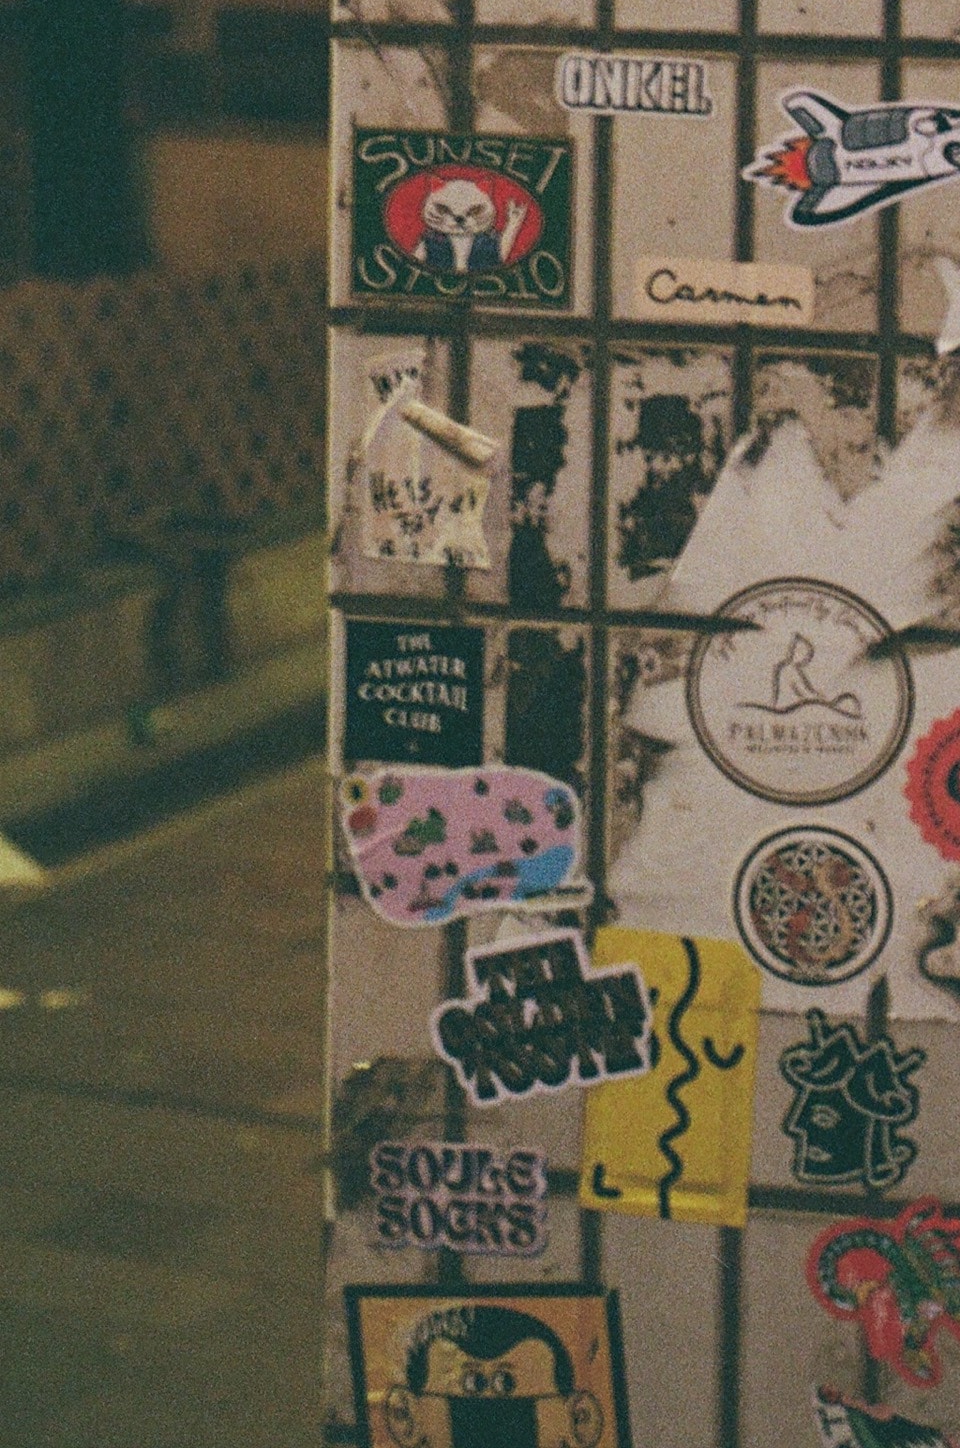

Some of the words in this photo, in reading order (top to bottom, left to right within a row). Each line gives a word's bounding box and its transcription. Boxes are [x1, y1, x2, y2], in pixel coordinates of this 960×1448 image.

[563, 57, 713, 115] ONKEL
[358, 135, 567, 193] SUNSET
[358, 243, 565, 298] STUDIO
[645, 267, 802, 311] Carmen
[357, 681, 469, 713] COCKTAIL
[384, 707, 442, 734] CLUB
